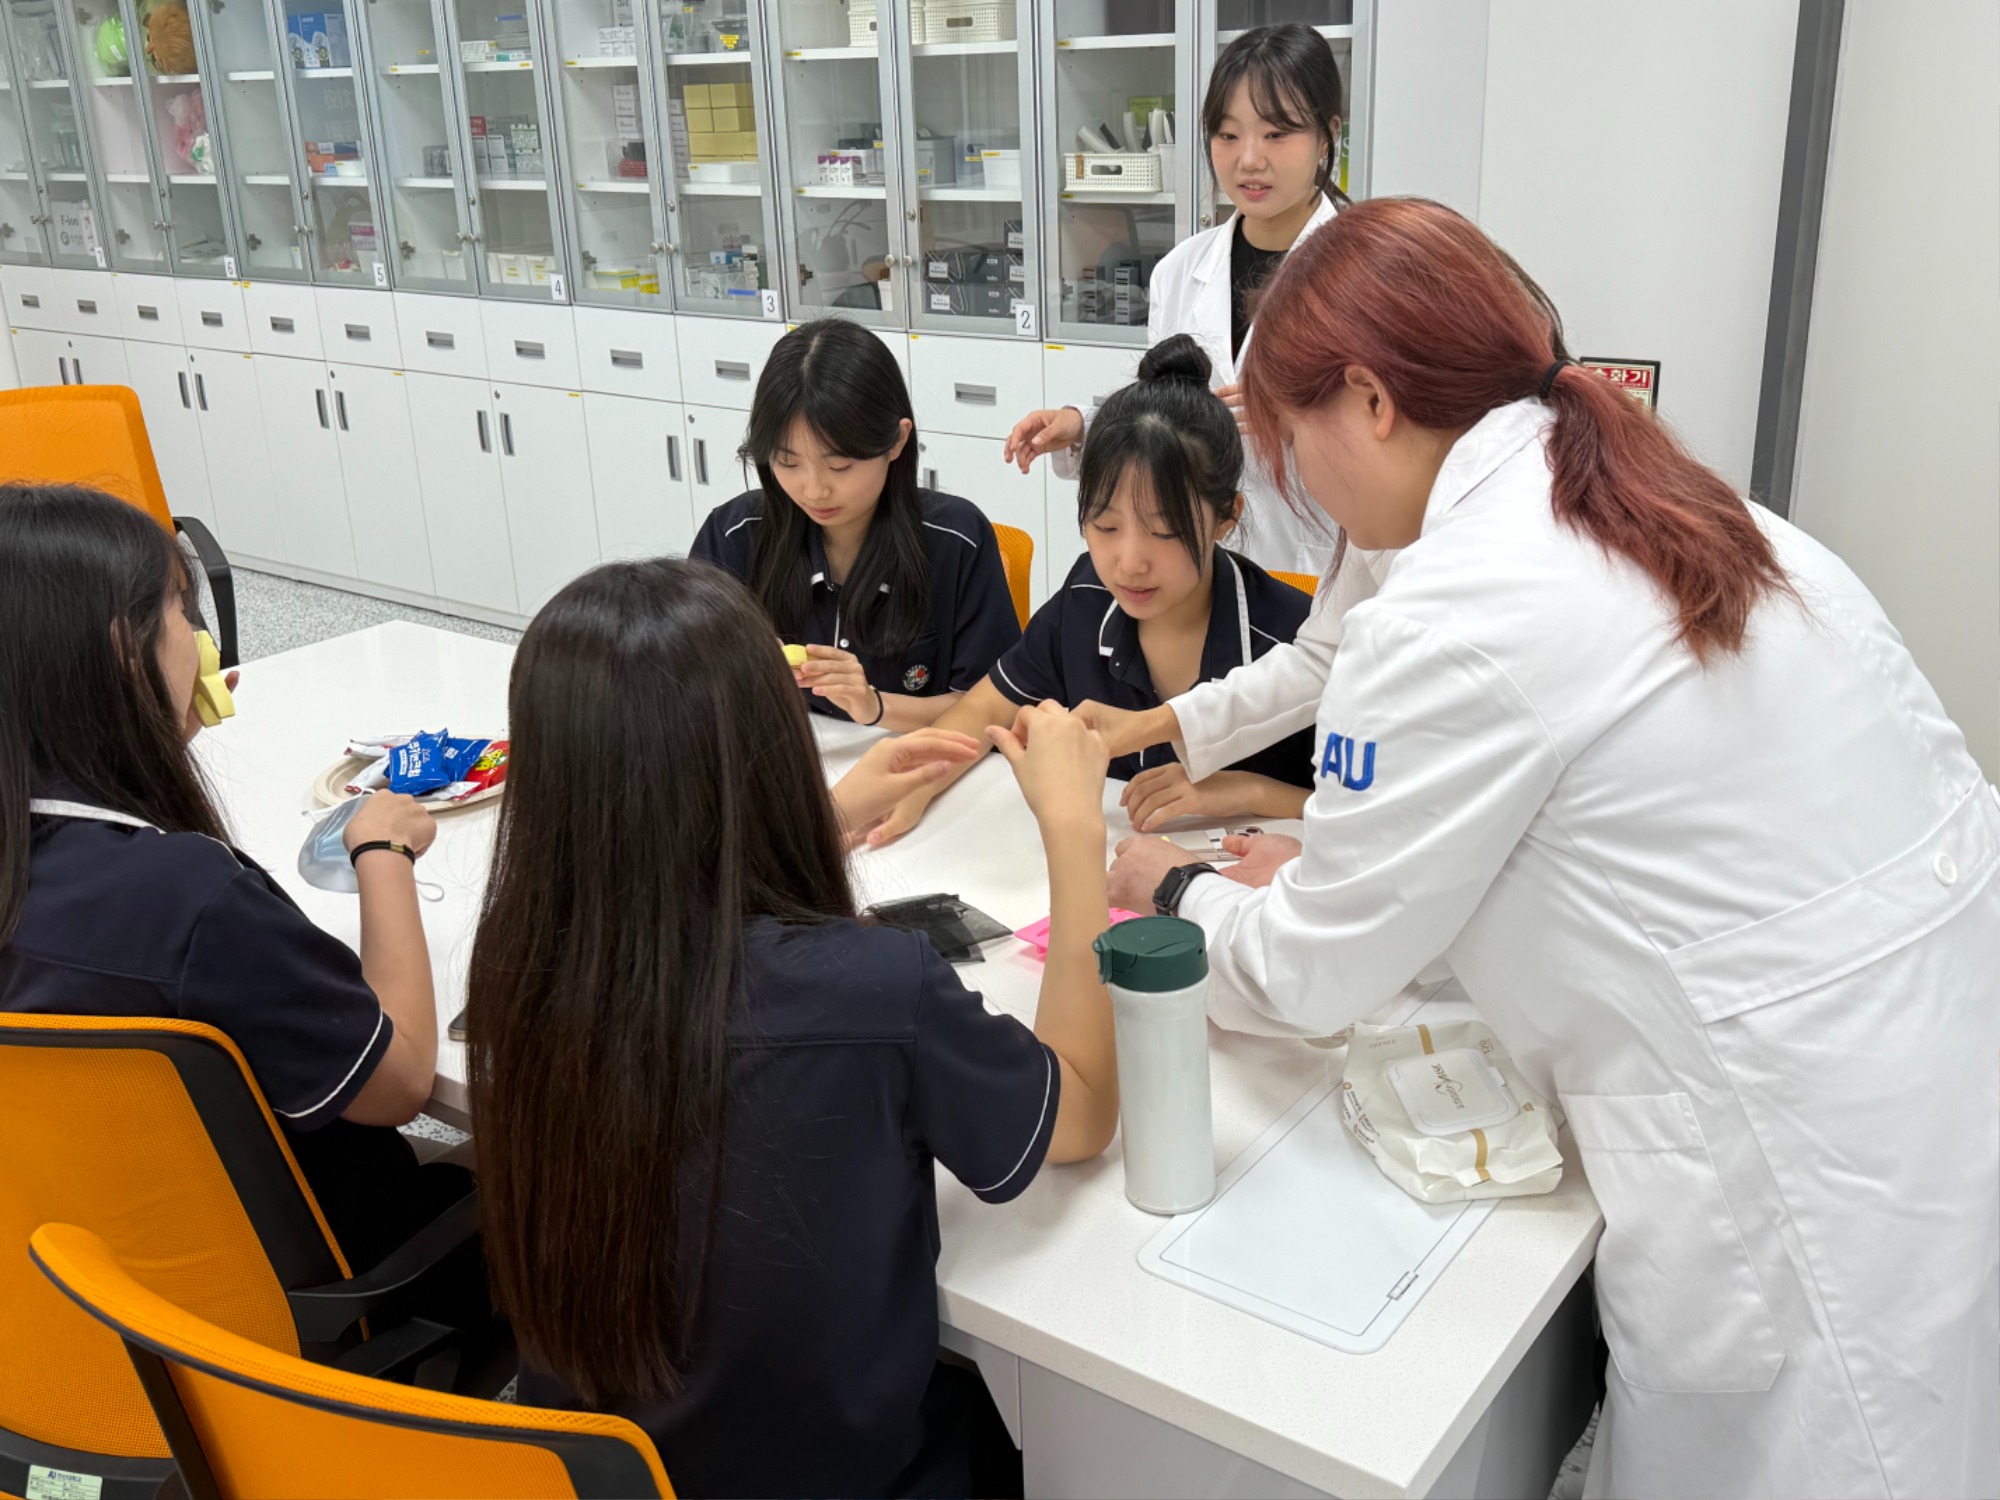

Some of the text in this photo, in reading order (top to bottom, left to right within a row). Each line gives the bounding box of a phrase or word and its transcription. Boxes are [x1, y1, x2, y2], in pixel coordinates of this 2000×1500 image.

[227, 261, 234, 275] 6
[376, 267, 385, 282] 5
[555, 279, 562, 295] 4
[766, 295, 775, 313] 3
[1020, 310, 1032, 329] 2
[1320, 732, 1376, 791] AU
